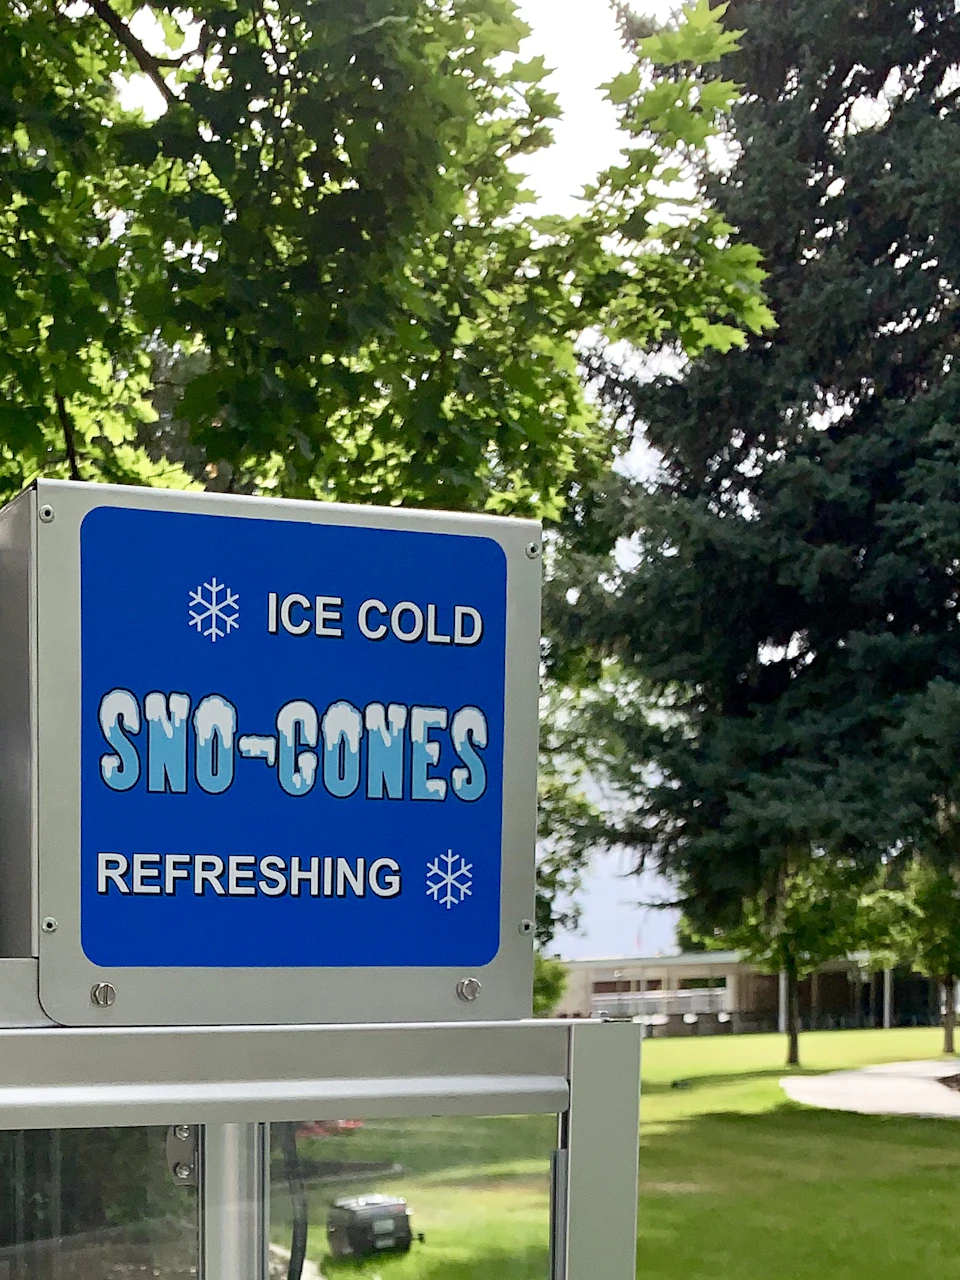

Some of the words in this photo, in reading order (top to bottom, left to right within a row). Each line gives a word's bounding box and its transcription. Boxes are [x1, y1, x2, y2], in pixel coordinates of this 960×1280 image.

[267, 592, 343, 637] ICE
[357, 599, 484, 646] COLD
[98, 688, 489, 802] SNO-CONES
[96, 853, 401, 897] REFRESHING
